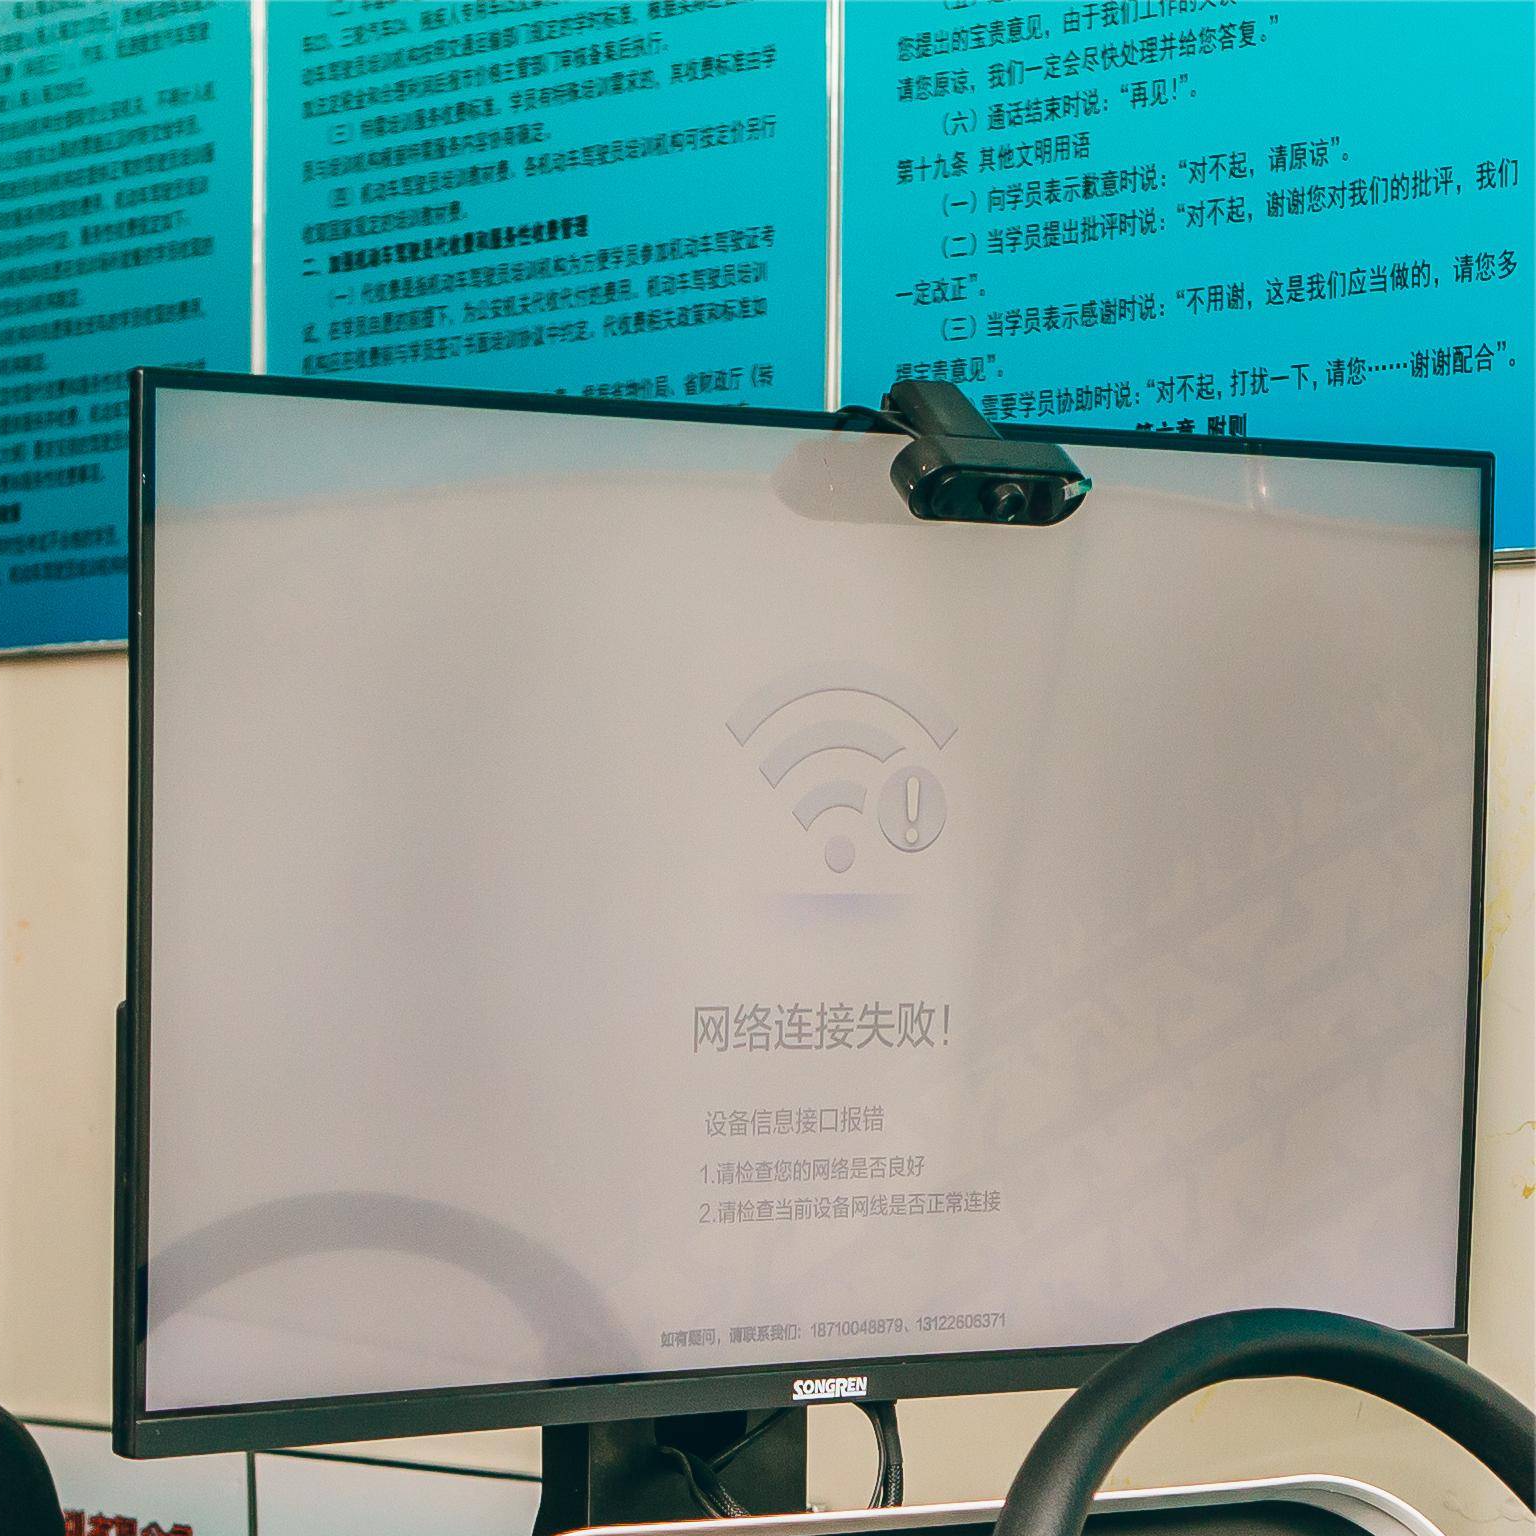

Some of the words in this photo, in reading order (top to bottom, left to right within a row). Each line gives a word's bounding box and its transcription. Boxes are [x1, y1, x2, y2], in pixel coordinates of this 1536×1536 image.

[978, 131, 1091, 174] 其他文明用语
[895, 273, 986, 307] 一定改正”。
[704, 1104, 885, 1139] 设备信息接口报错
[699, 1154, 926, 1187] 1.请检查您的网络是否良好
[698, 1190, 1001, 1226] 2.请检查当前设备网线是否正常连接
[792, 1376, 868, 1400] SONGREN
